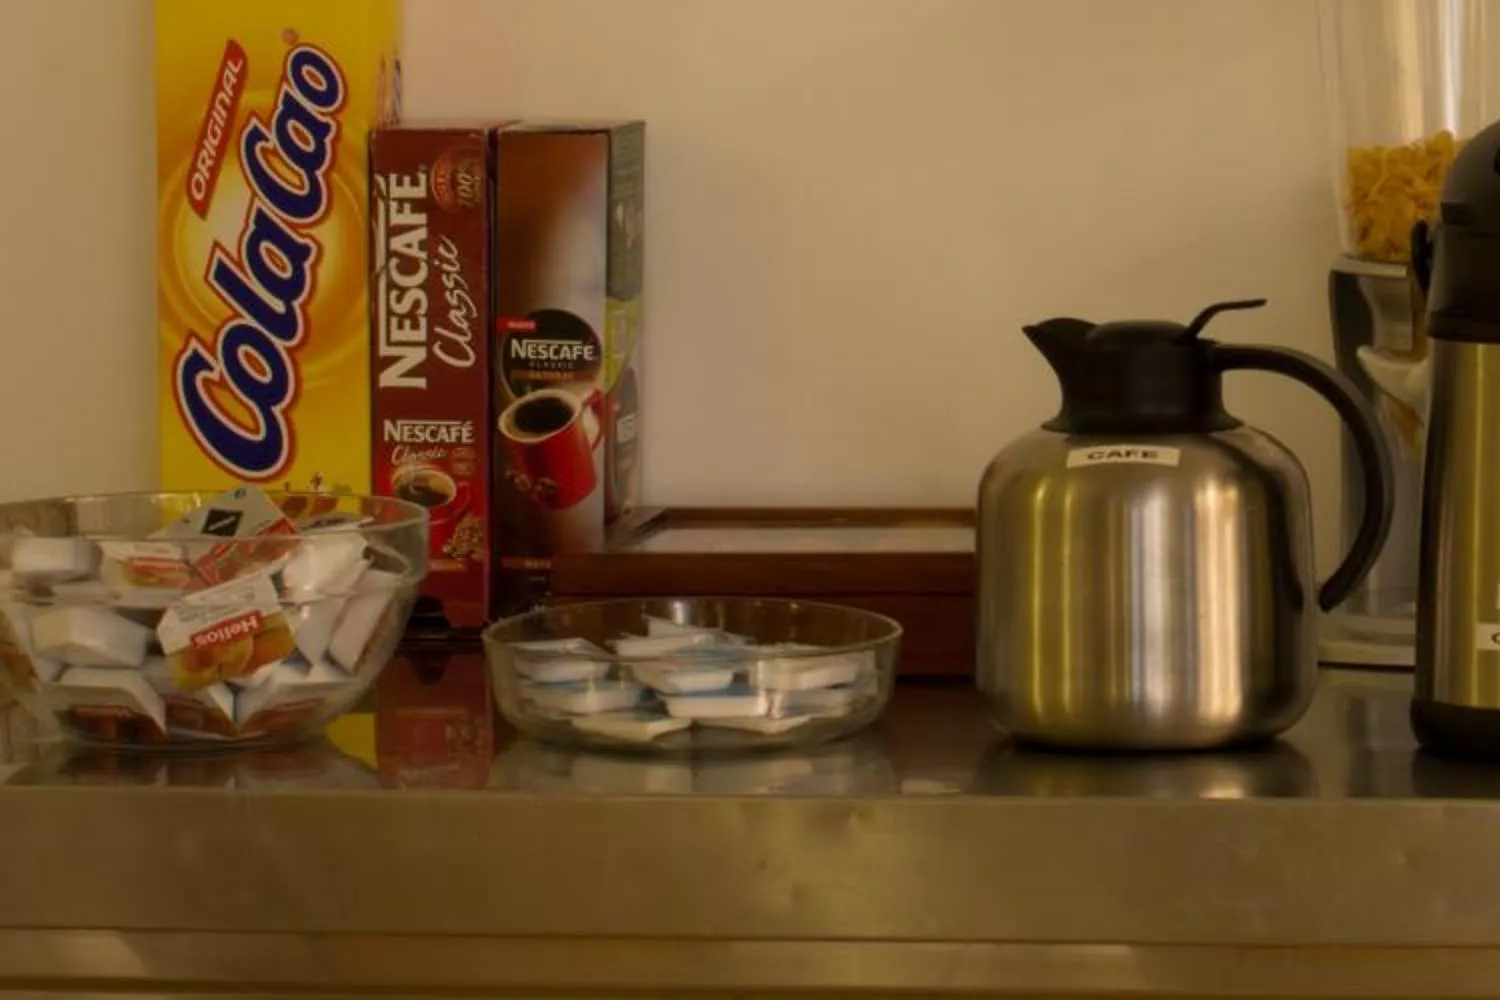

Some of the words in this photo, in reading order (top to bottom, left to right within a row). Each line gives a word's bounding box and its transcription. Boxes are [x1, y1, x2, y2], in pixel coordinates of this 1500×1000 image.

[190, 56, 244, 202] ORIGINAL
[374, 172, 429, 390] NESCAFÉ
[432, 234, 478, 368] Classic
[383, 418, 475, 444] NESCAFÉ
[1086, 450, 1159, 461] CAFE
